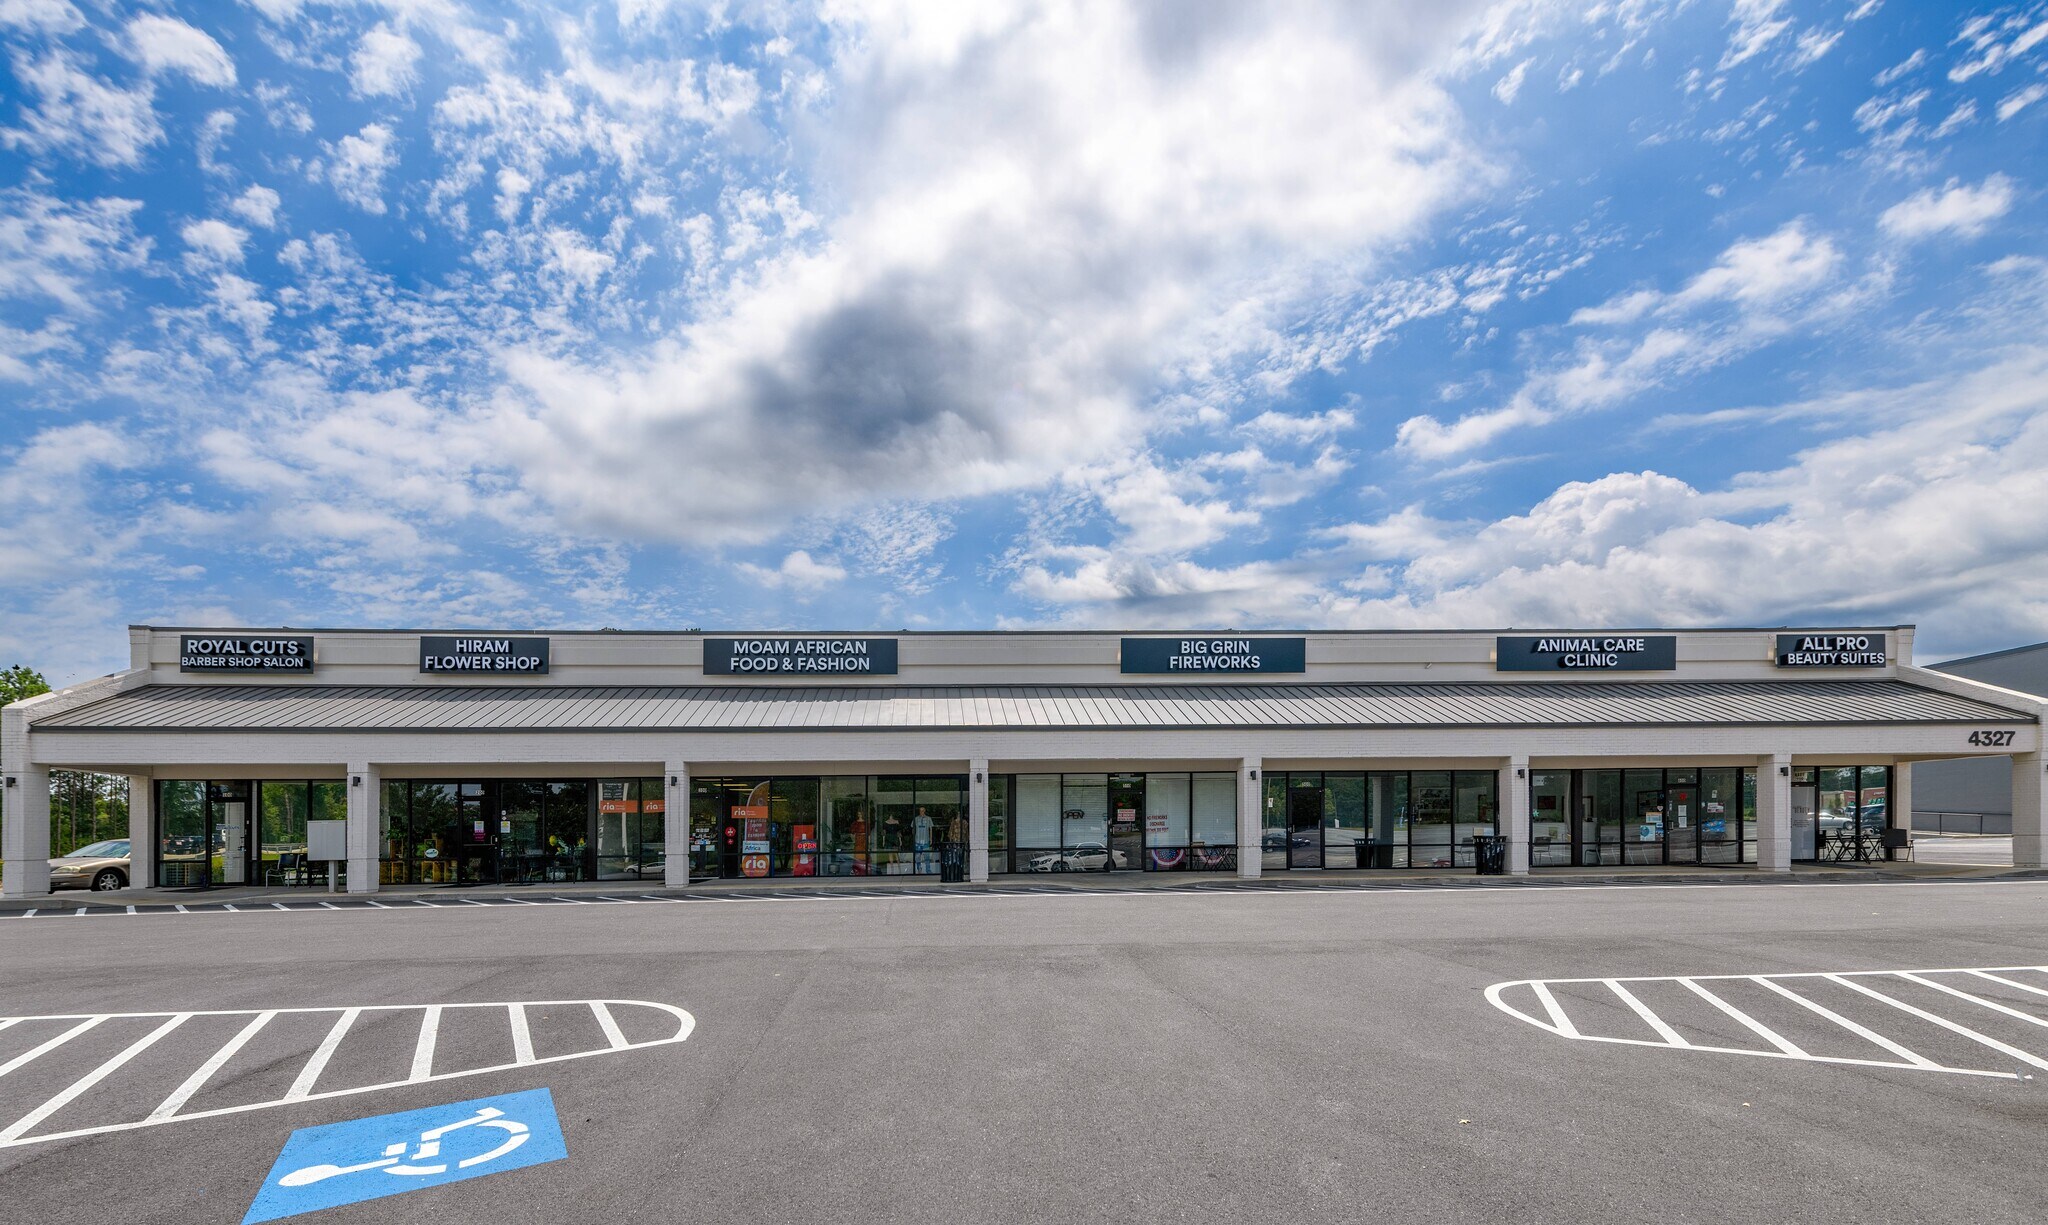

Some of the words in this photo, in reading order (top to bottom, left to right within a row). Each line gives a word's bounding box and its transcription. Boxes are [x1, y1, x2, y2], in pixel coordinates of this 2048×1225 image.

[187, 640, 245, 654] ROYAL
[249, 640, 298, 654] CUTS
[456, 640, 509, 653] HIRAM
[733, 641, 790, 654] MOAM
[794, 641, 867, 654] AFRICAN
[1181, 641, 1207, 654] BIG
[1210, 641, 1250, 654] GRIN
[1537, 639, 1600, 652] ANIMAL
[1603, 639, 1645, 651] CARE
[1802, 637, 1833, 650] ALL
[1836, 637, 1869, 650] PRO
[181, 657, 226, 667] BARBER
[228, 657, 261, 667] SHOP
[263, 657, 303, 667] SALON
[425, 656, 492, 669] FLOWER
[495, 656, 540, 669] SHOP
[730, 657, 778, 671] FOOD
[782, 657, 794, 671] &
[797, 657, 870, 671] FASHION
[1169, 656, 1261, 669] FIREWORKS
[1564, 653, 1618, 667] CLINIC
[1788, 653, 1837, 664] BEAUTY
[1840, 652, 1885, 664] SUITES
[1968, 730, 2016, 747] 4327
[602, 802, 615, 810] ria
[646, 802, 658, 810] ria
[734, 808, 746, 816] ria
[745, 855, 767, 869] ria
